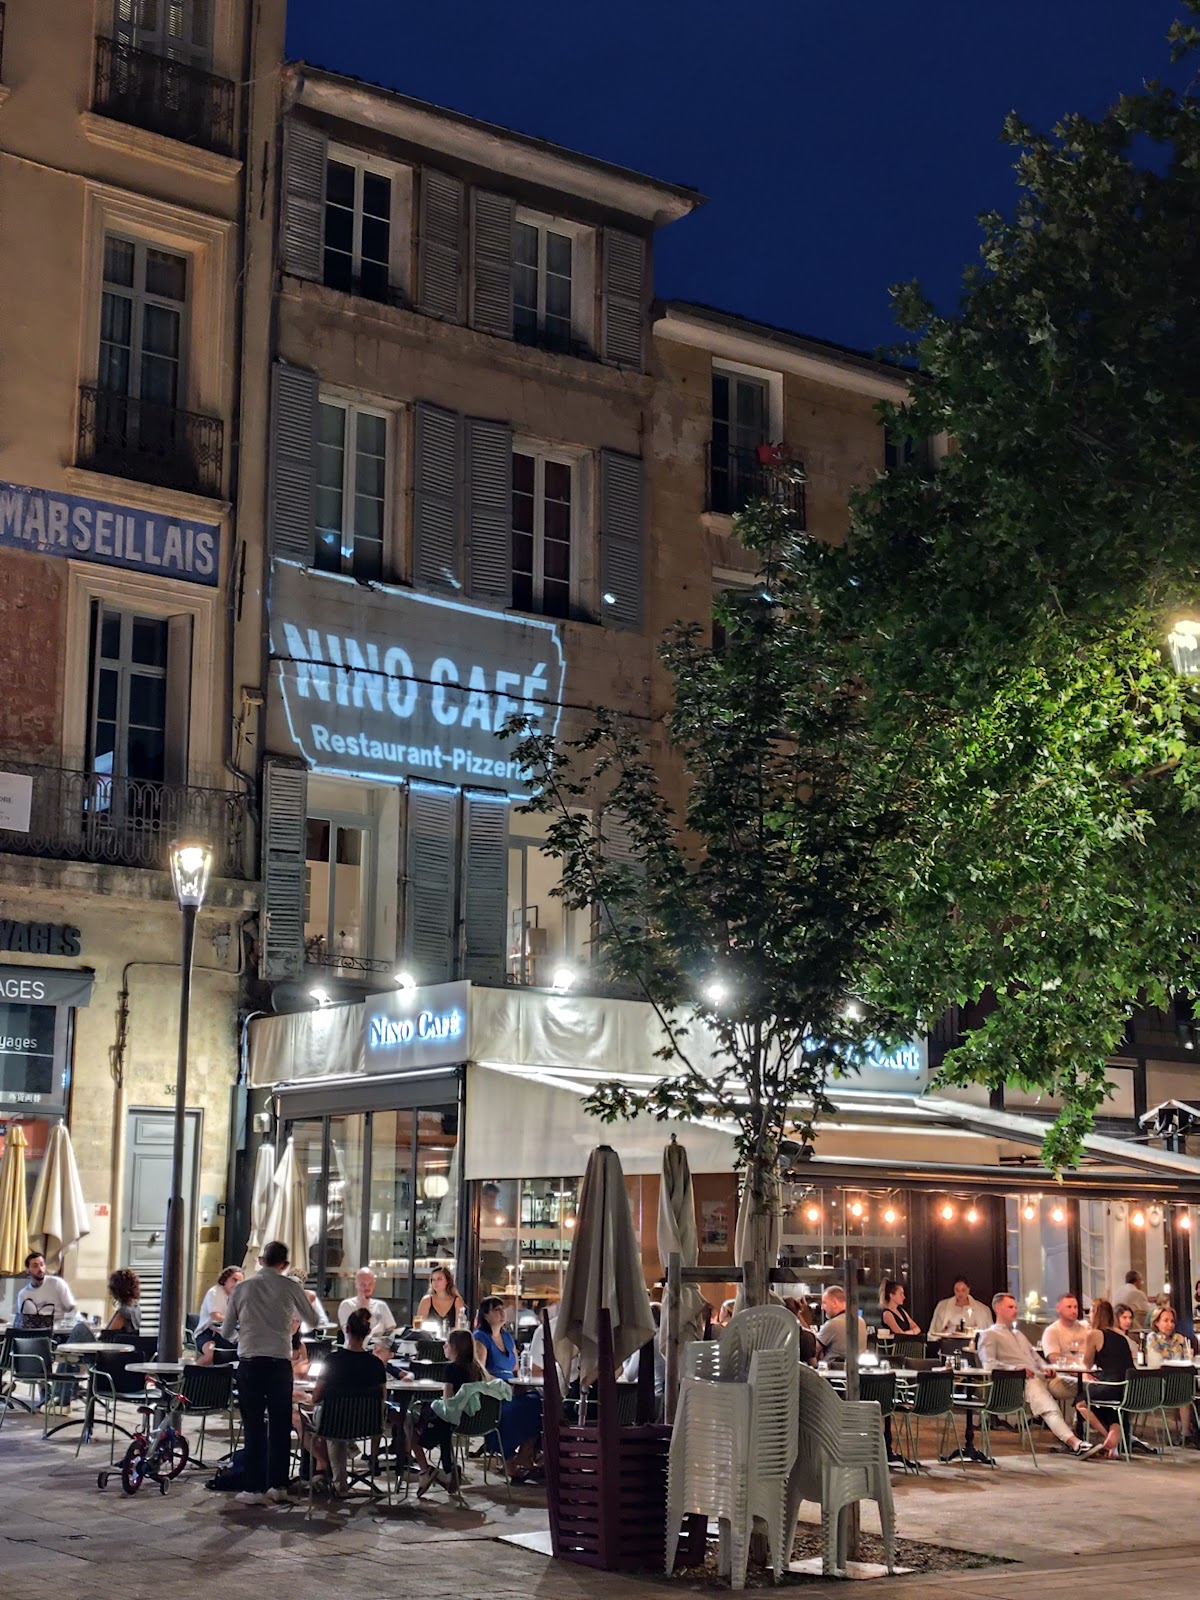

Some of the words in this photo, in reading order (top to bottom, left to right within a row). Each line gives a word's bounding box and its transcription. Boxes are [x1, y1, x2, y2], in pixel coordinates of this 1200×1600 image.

[0, 491, 214, 575] MARSEILLAIS
[282, 622, 420, 718] NINO
[430, 662, 548, 737] CAFÉ
[310, 723, 533, 781] Restaurant-Pizzeria
